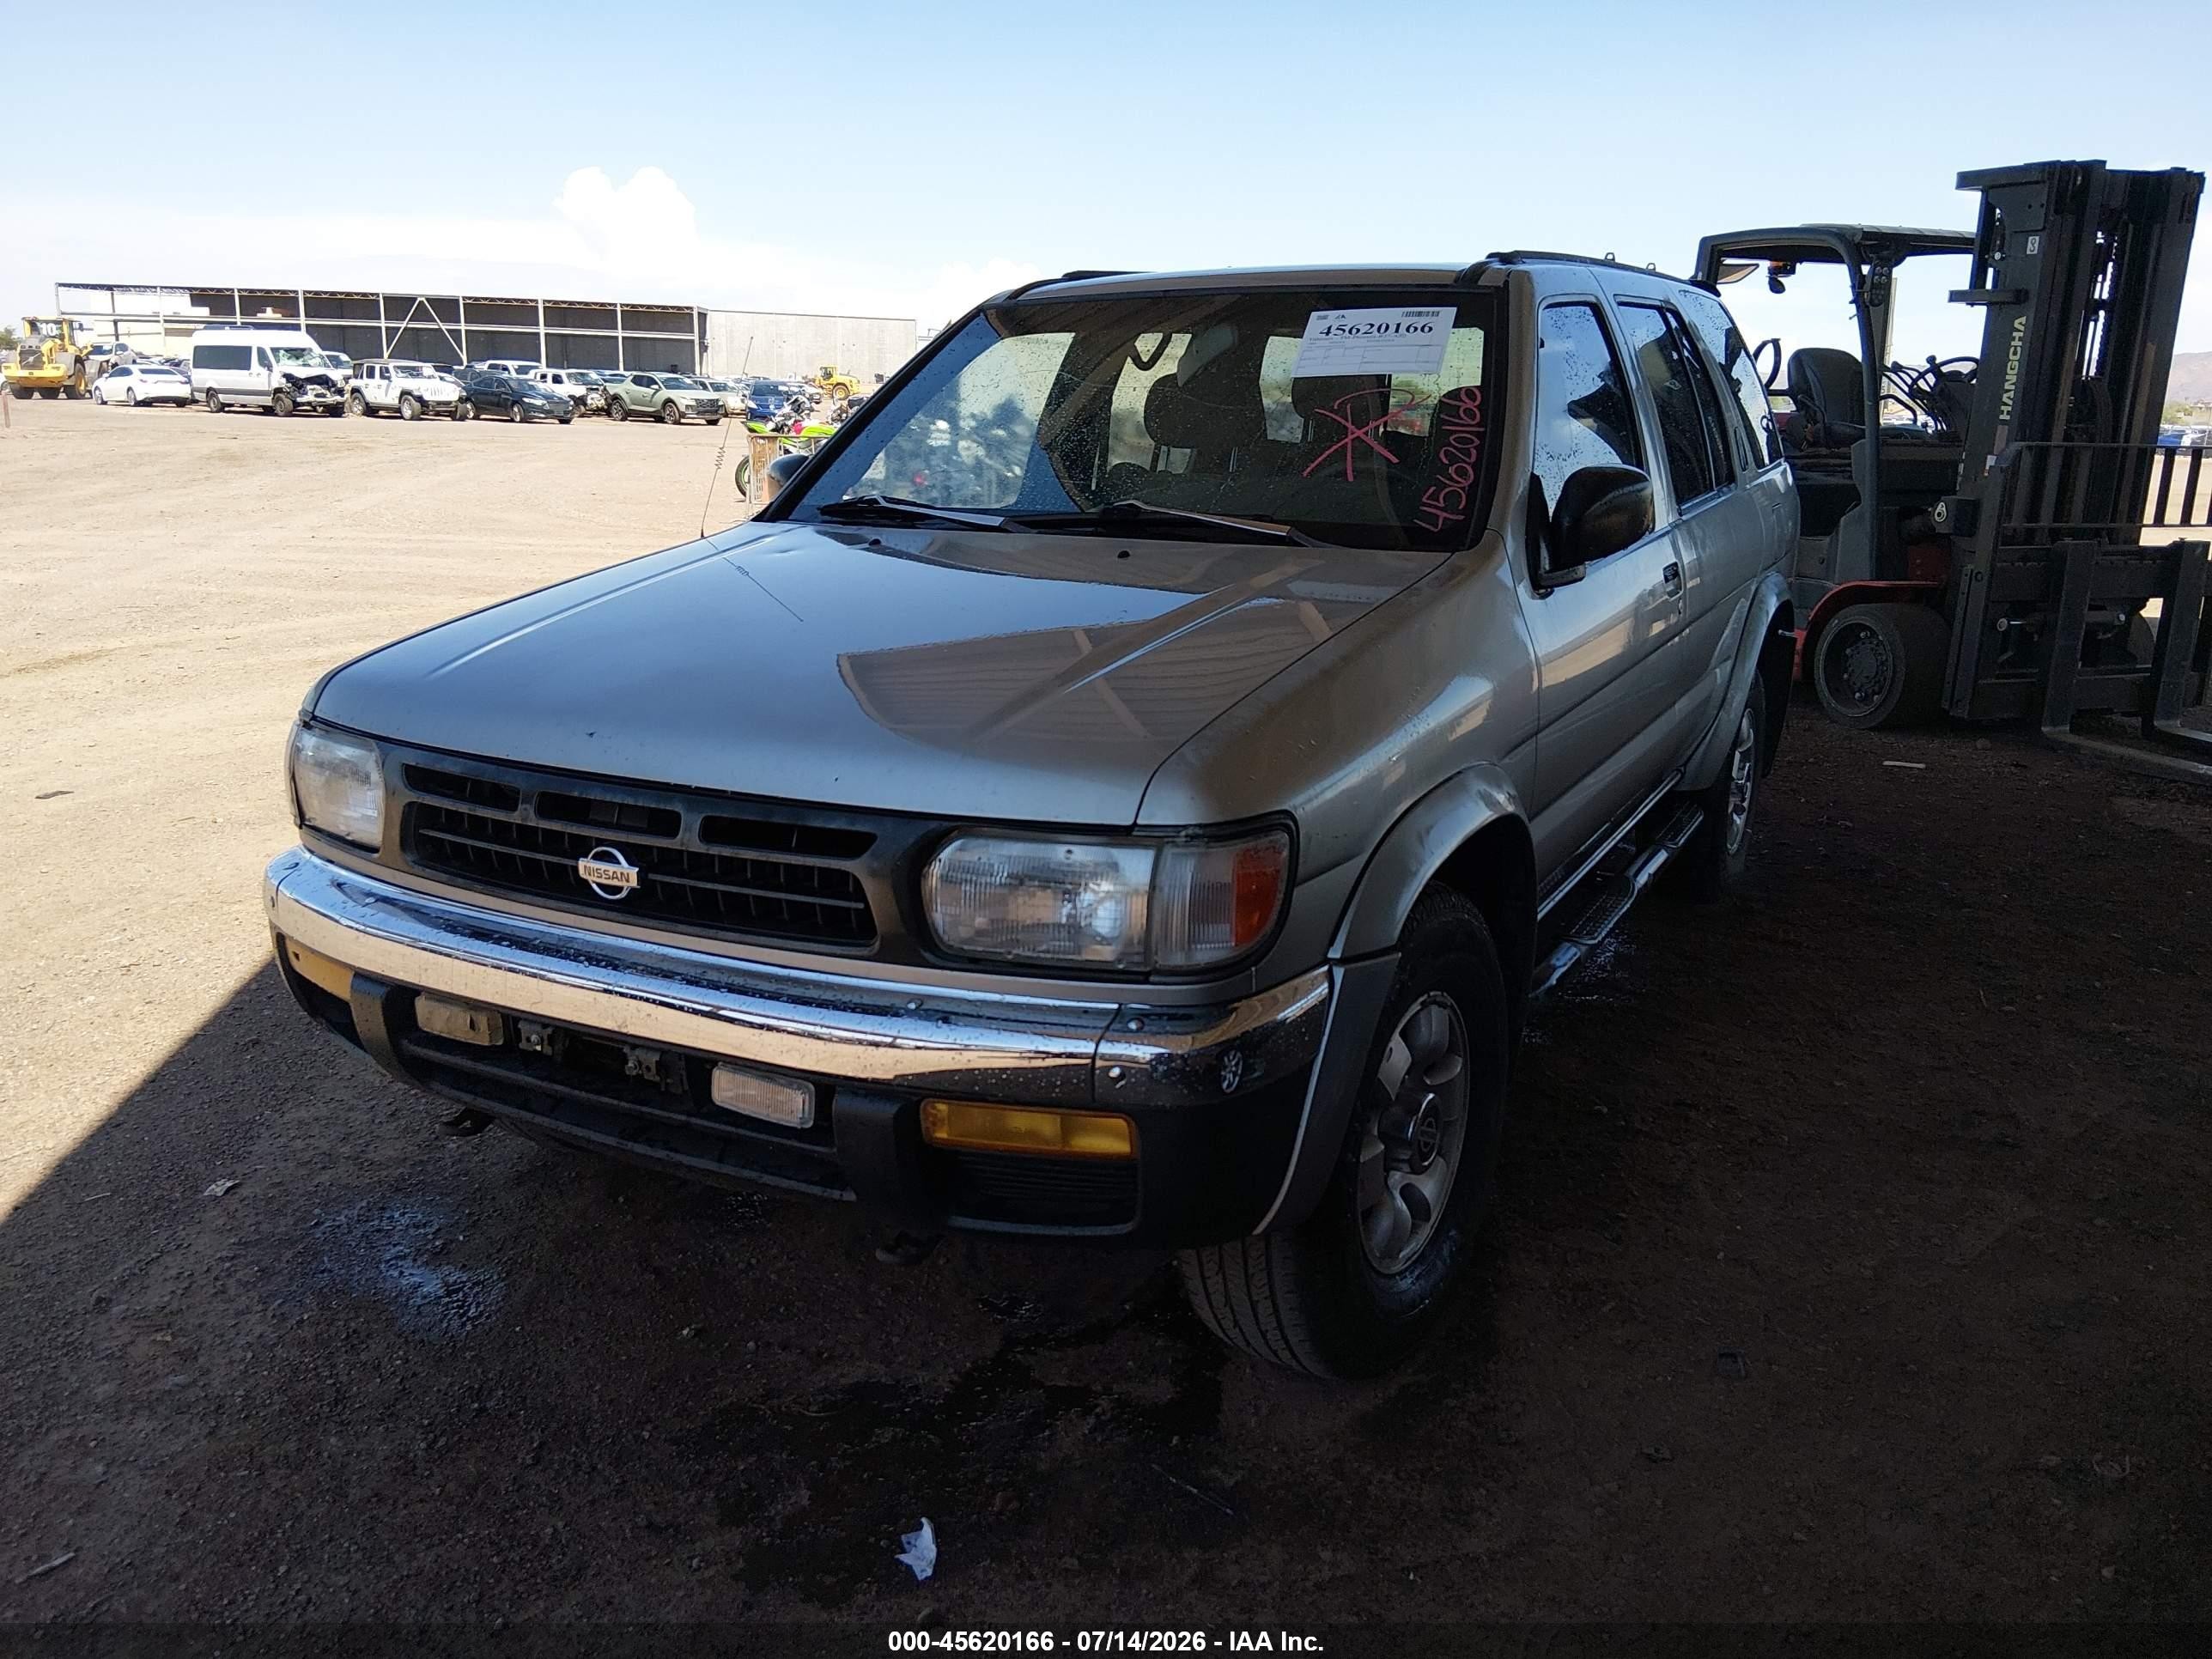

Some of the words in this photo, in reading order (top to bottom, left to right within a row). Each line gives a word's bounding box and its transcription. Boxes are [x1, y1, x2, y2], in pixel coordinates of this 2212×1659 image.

[40, 322, 57, 337] 10
[1319, 321, 1435, 337] 45620166
[1999, 315, 2027, 420] HANGCHA
[1413, 386, 1485, 532] 45620166
[584, 865, 630, 883] NISSAN
